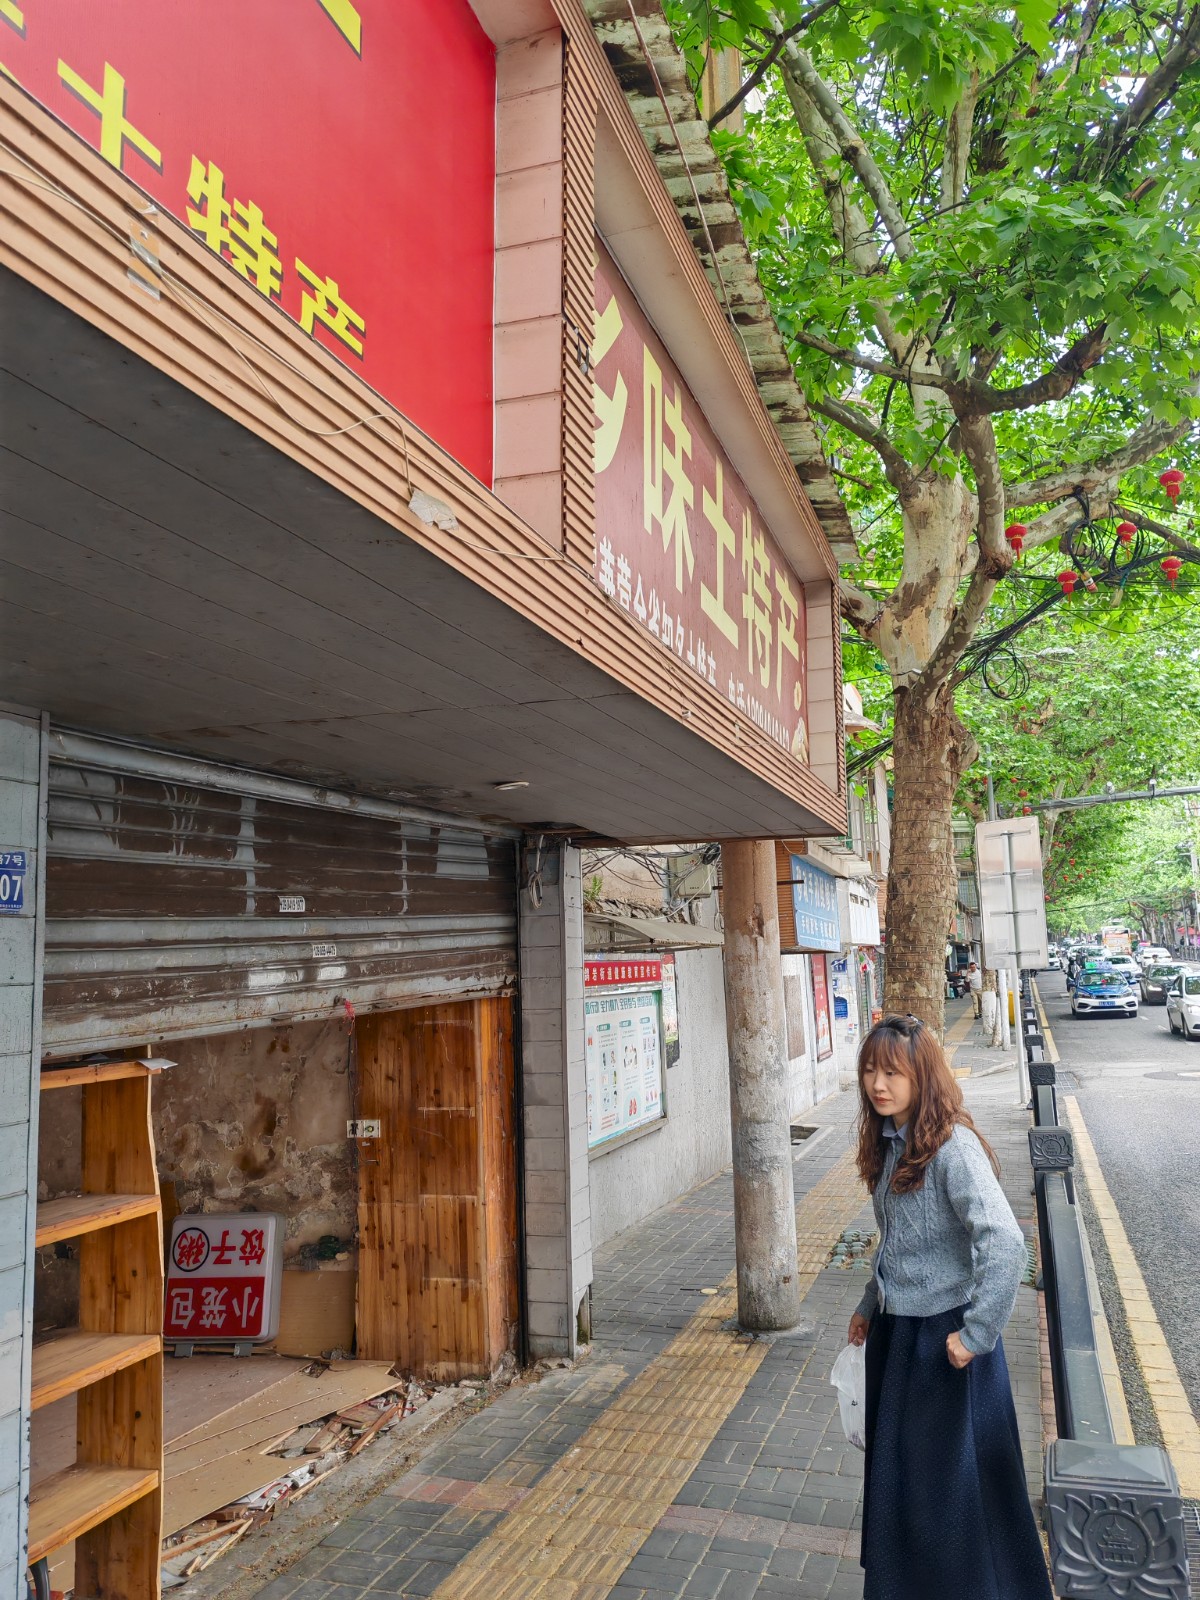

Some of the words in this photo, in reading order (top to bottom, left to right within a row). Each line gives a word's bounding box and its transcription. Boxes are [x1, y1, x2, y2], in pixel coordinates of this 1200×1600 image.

[0, 854, 24, 866] 7号
[170, 1286, 260, 1330] 小笼包
